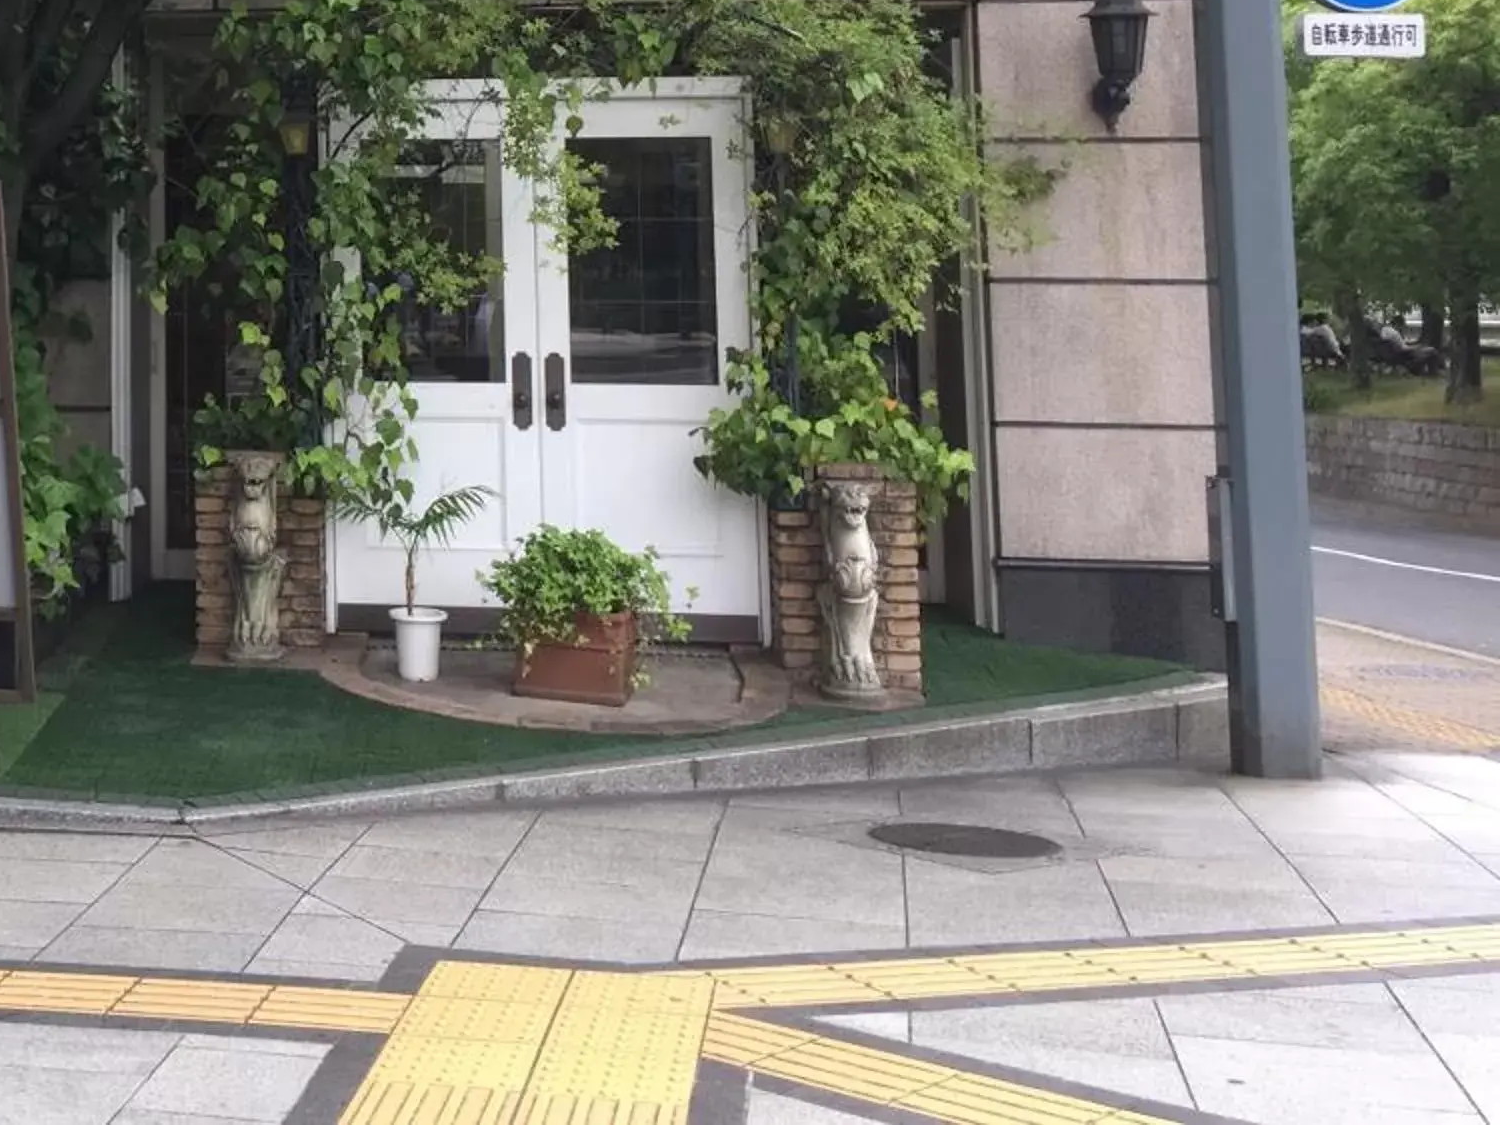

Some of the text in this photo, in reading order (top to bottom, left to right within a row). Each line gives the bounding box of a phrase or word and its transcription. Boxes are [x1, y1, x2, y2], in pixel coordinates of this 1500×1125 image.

[1311, 23, 1417, 47] 自転車歩道通行可
